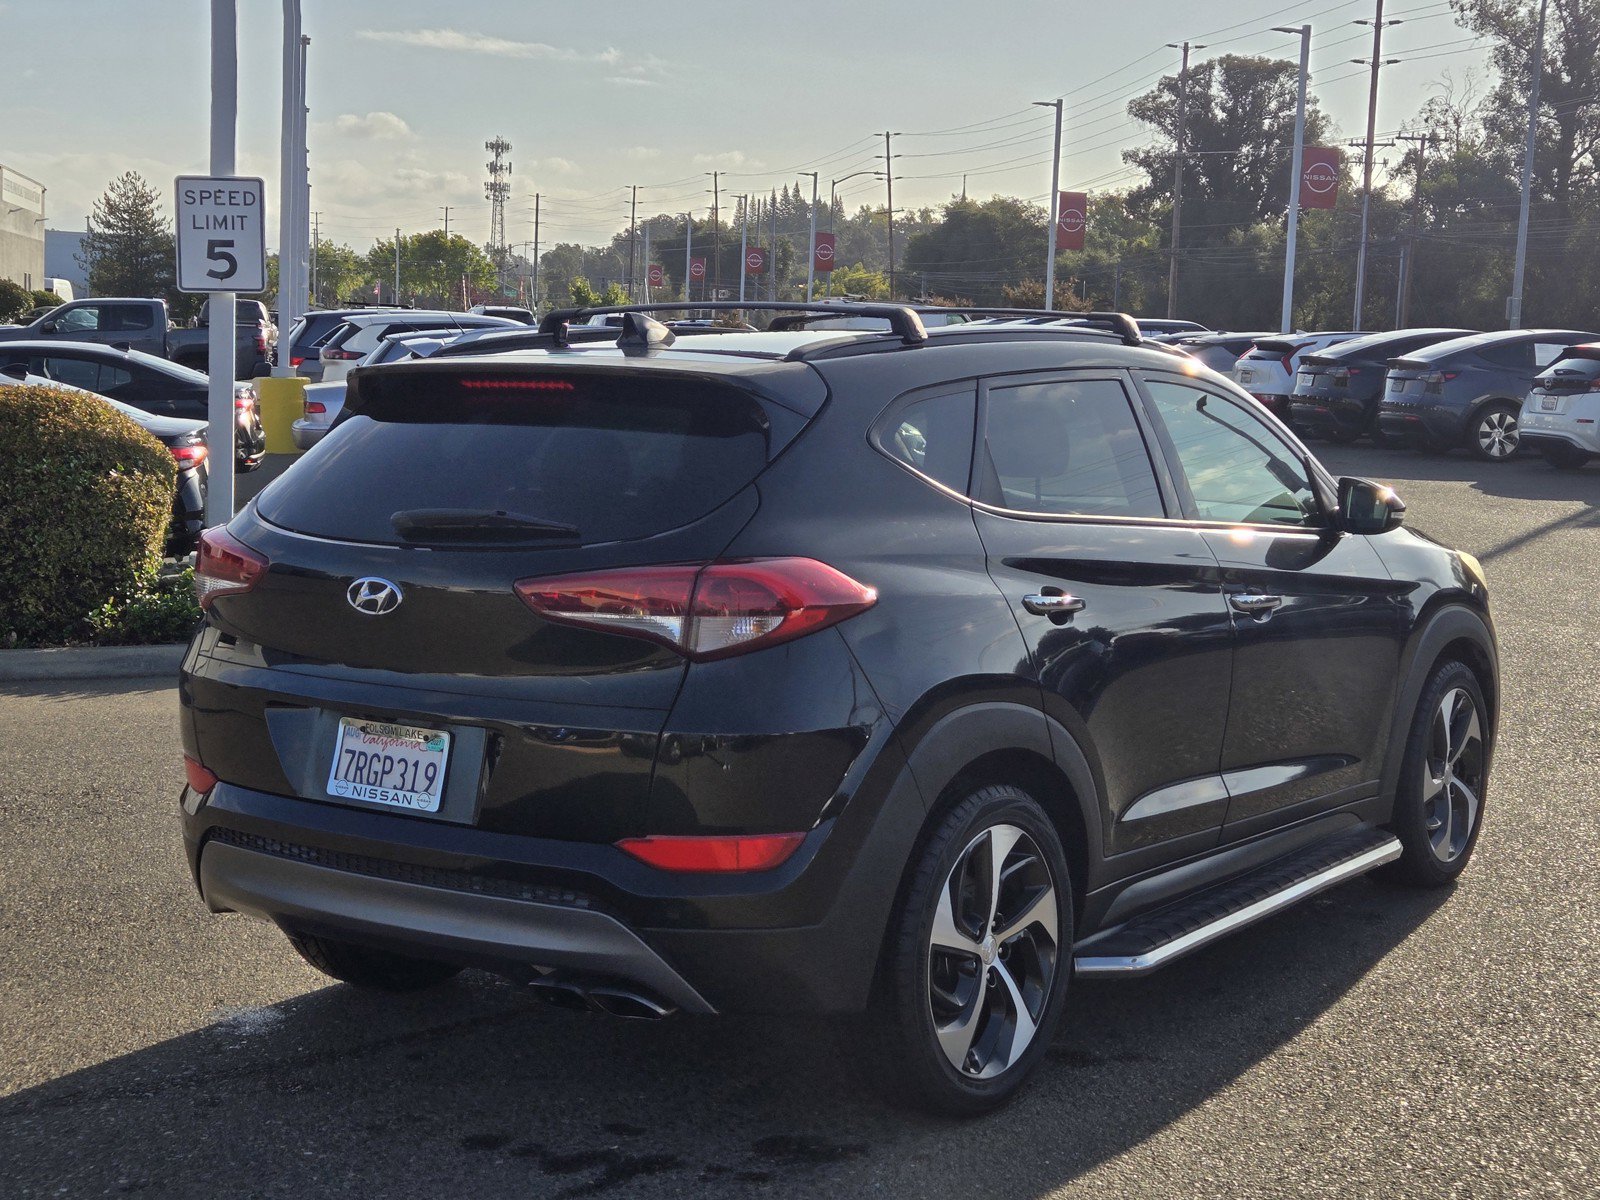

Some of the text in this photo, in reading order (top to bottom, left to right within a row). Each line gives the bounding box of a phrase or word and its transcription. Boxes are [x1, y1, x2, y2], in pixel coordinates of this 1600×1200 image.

[184, 189, 256, 206] SPEED
[192, 214, 248, 230] LIMIT
[206, 239, 238, 280] 5
[345, 726, 360, 738] AUG
[365, 722, 424, 740] FOLSOM LAKE
[344, 748, 438, 794] 7RGP319
[352, 785, 413, 805] NISSAN
